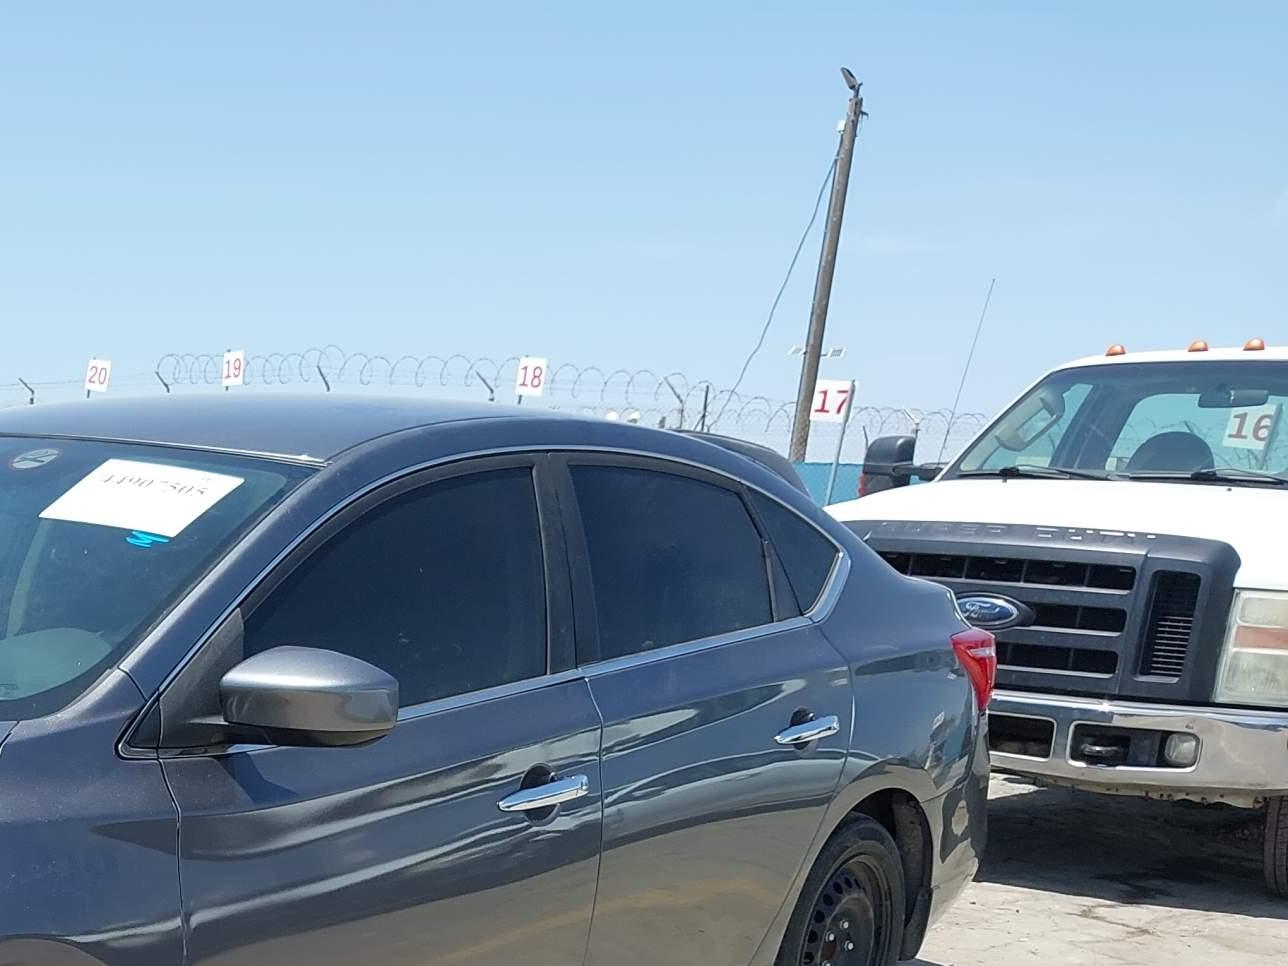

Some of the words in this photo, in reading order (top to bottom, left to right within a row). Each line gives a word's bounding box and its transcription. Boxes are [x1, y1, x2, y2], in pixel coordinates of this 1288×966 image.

[88, 365, 108, 386] 20
[224, 358, 242, 380] 19
[518, 365, 543, 389] 18
[814, 389, 850, 415] 17
[1227, 411, 1274, 442] 16
